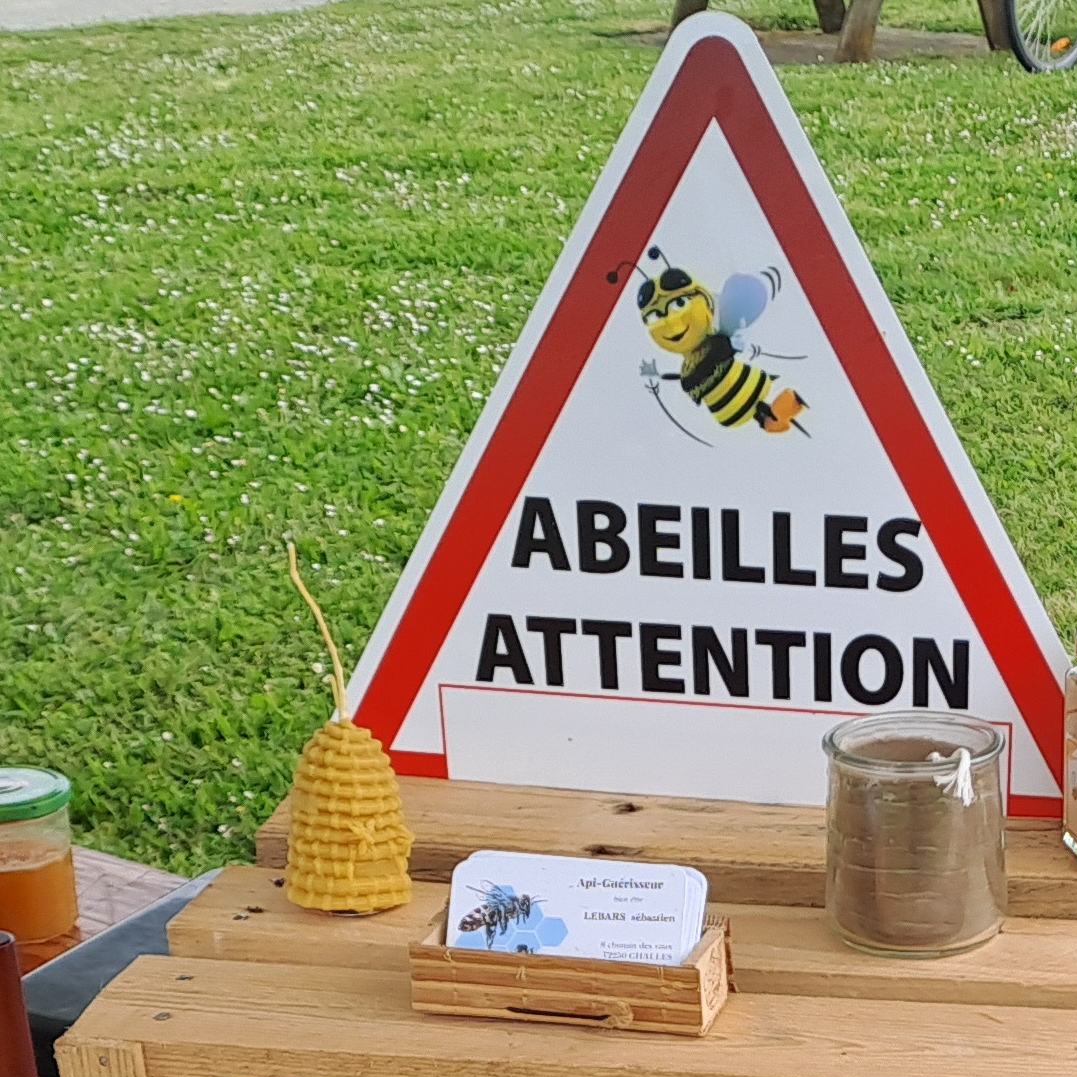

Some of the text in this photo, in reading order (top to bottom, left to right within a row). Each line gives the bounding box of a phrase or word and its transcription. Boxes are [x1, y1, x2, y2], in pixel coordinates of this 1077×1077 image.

[511, 495, 925, 592] ABEILLES
[474, 613, 971, 710] ATTENTION
[583, 911, 626, 922] LEBARS
